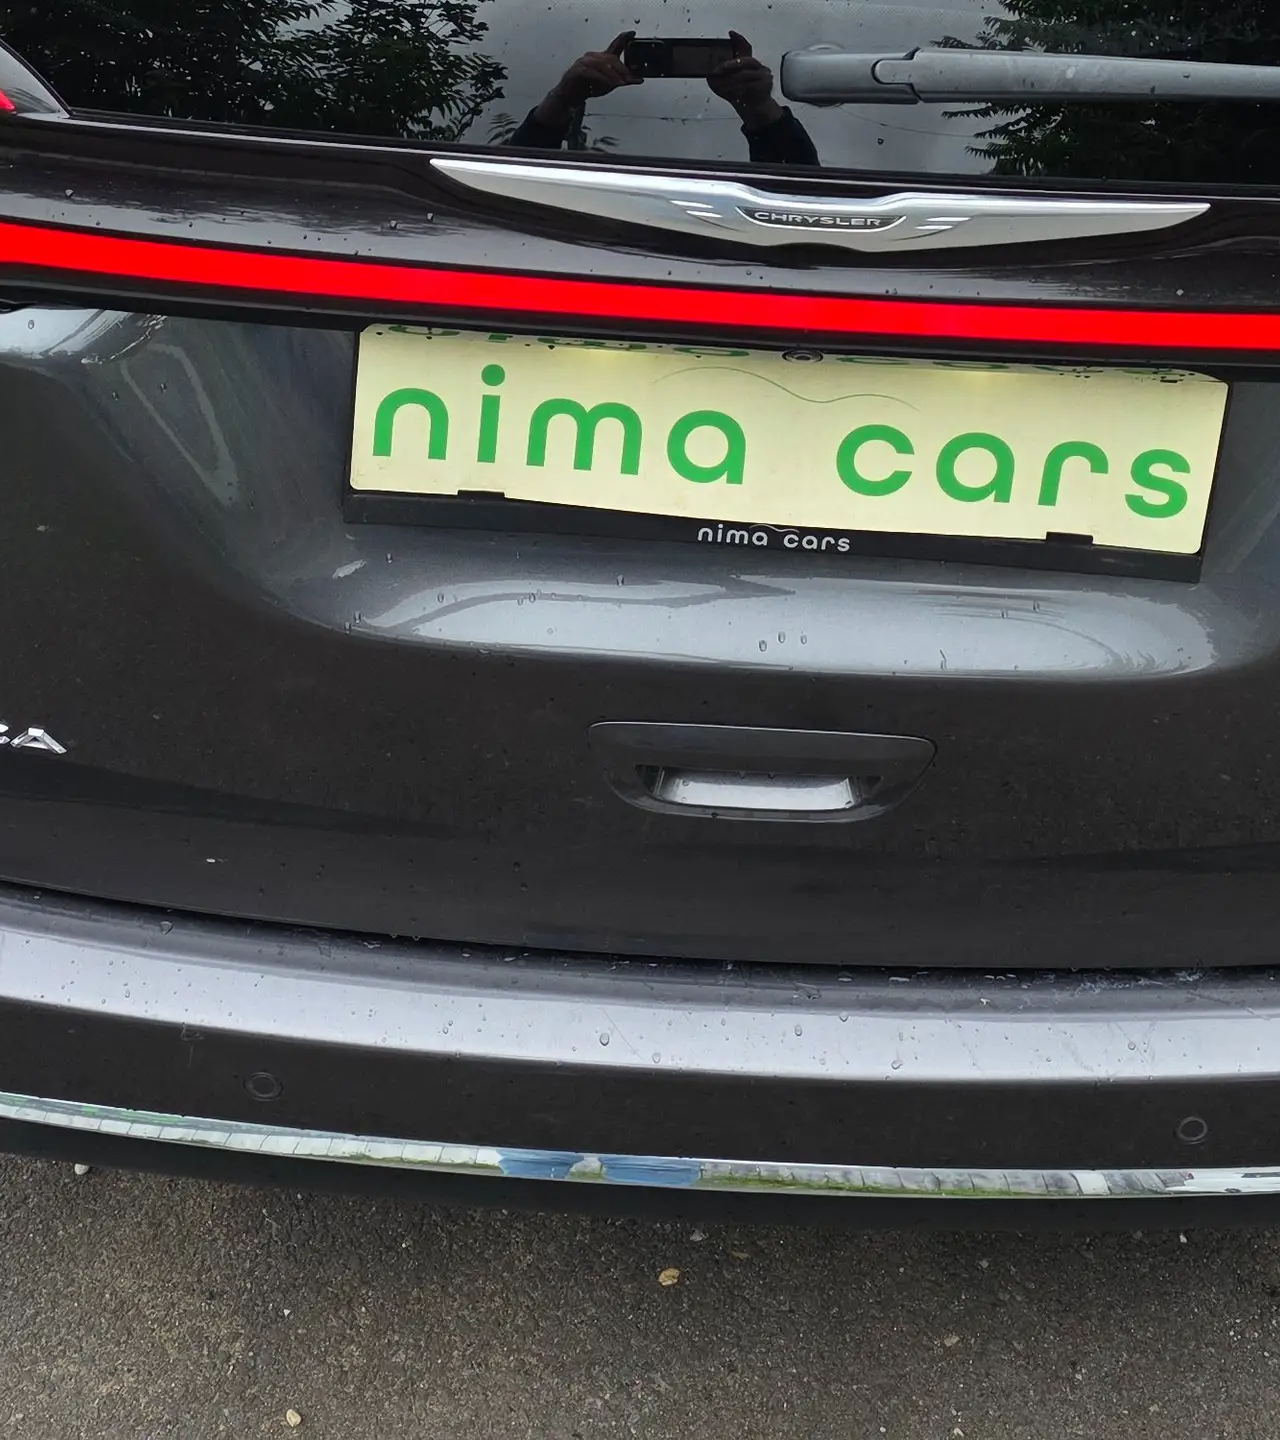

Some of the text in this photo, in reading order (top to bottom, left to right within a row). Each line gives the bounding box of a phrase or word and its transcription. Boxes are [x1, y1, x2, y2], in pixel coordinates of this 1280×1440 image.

[753, 210, 882, 227] CHRYSLER
[372, 363, 1192, 520] nima cars
[697, 523, 851, 552] nima cars
